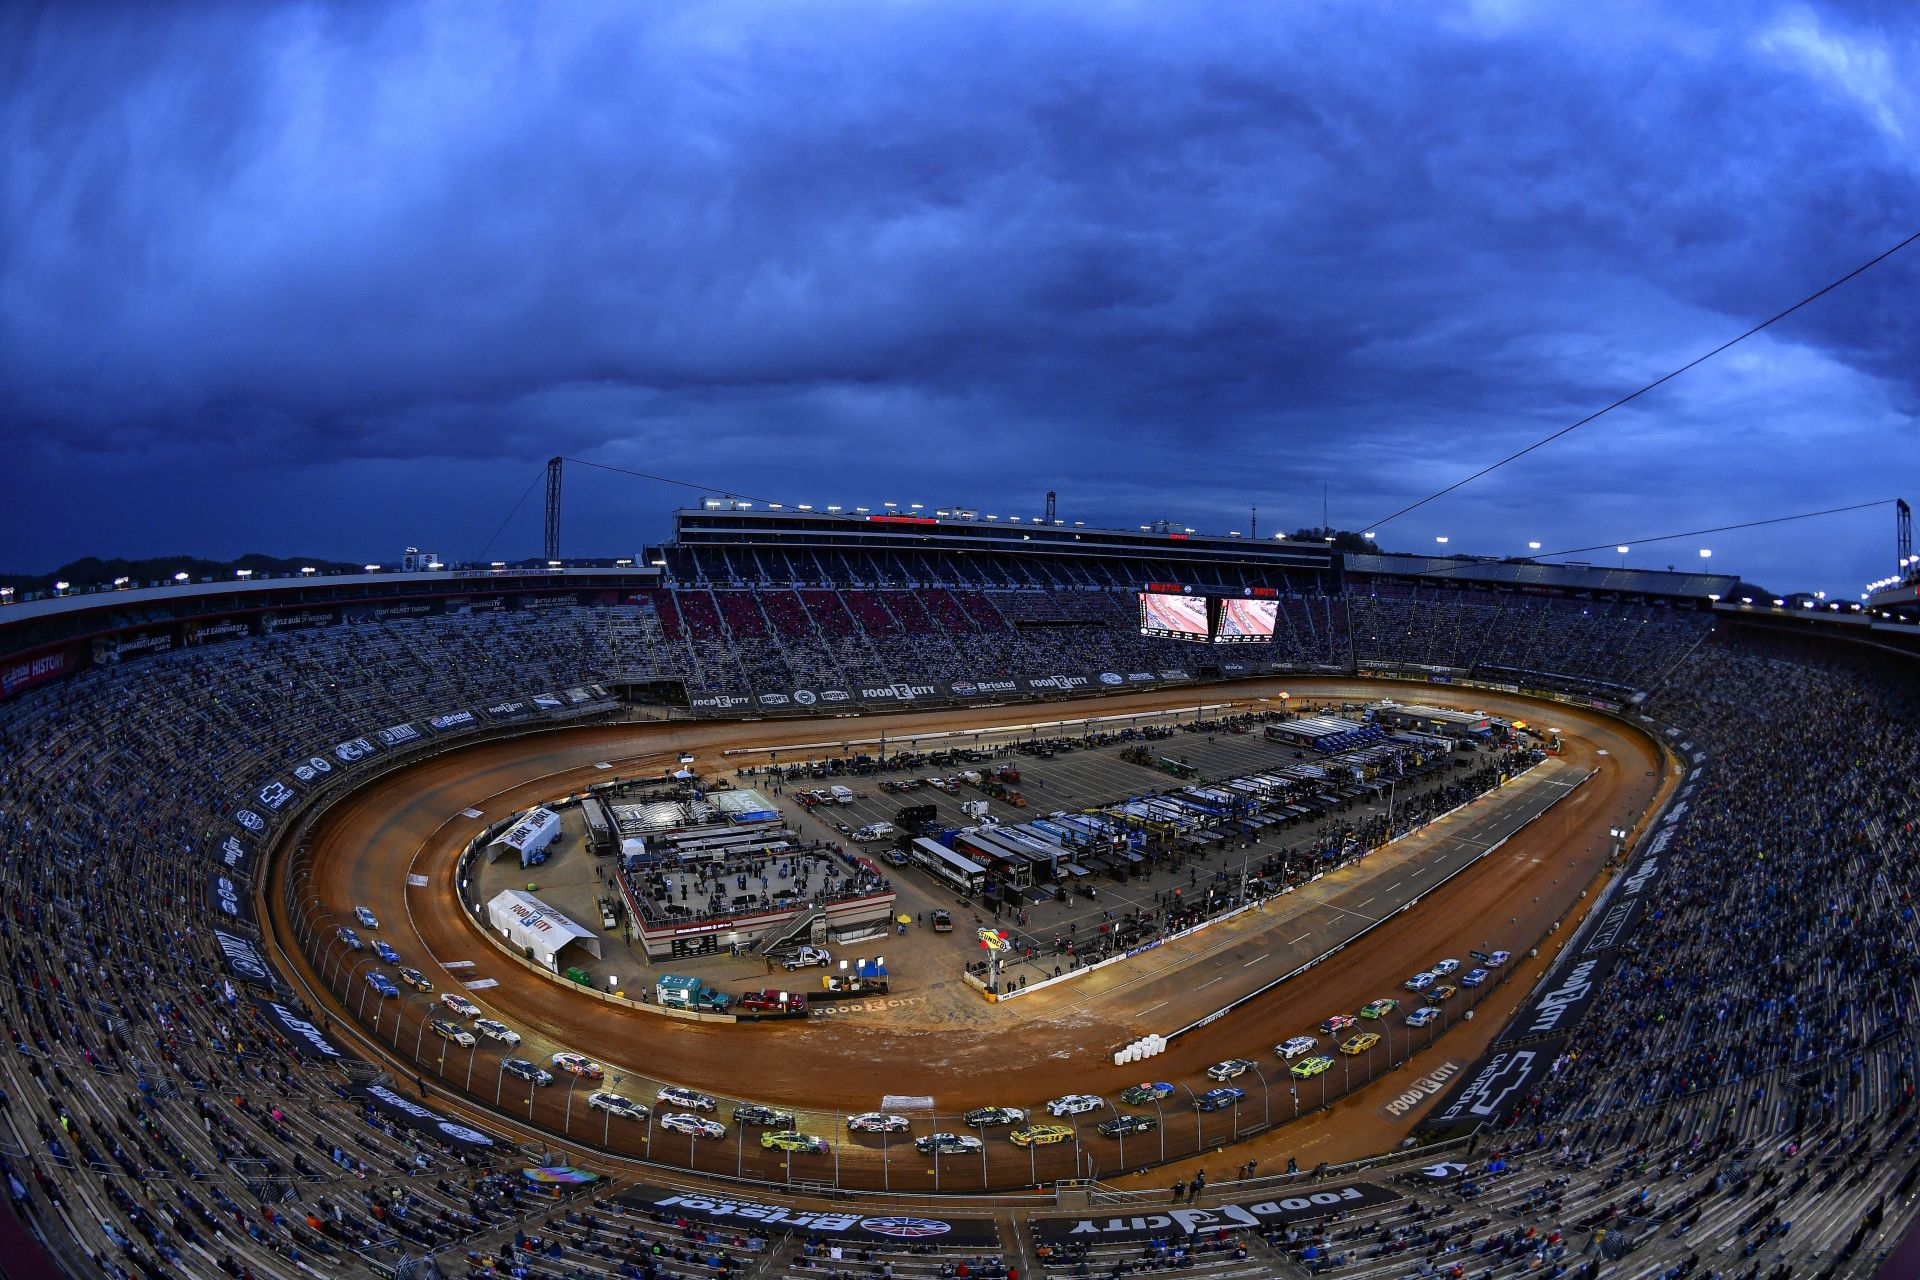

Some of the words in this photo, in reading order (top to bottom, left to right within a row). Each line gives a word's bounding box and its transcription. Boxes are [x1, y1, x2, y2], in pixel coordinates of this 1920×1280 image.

[32, 653, 65, 677] HISTORY
[861, 687, 894, 698] FOOD
[912, 685, 936, 695] CITY
[977, 680, 1016, 690] Bristol
[1029, 678, 1055, 688] FOOD
[1067, 677, 1088, 685] CITY
[731, 697, 749, 705] CITY
[443, 711, 471, 724] Bristol
[510, 904, 530, 918] FOOD
[533, 919, 553, 932] CITY
[979, 931, 1005, 951] SUNOCO
[814, 1003, 864, 1016] FOOD
[888, 996, 927, 1008] CITY
[1384, 1088, 1424, 1116] FOOD
[1430, 1061, 1459, 1082] CITY
[1439, 1053, 1509, 1121] CHEVROLET
[681, 1193, 792, 1213] Speedway
[1250, 1188, 1364, 1215] FOOD
[654, 1196, 858, 1231] Bristol
[797, 1211, 864, 1220] Motor
[1069, 1215, 1172, 1233] CITY
